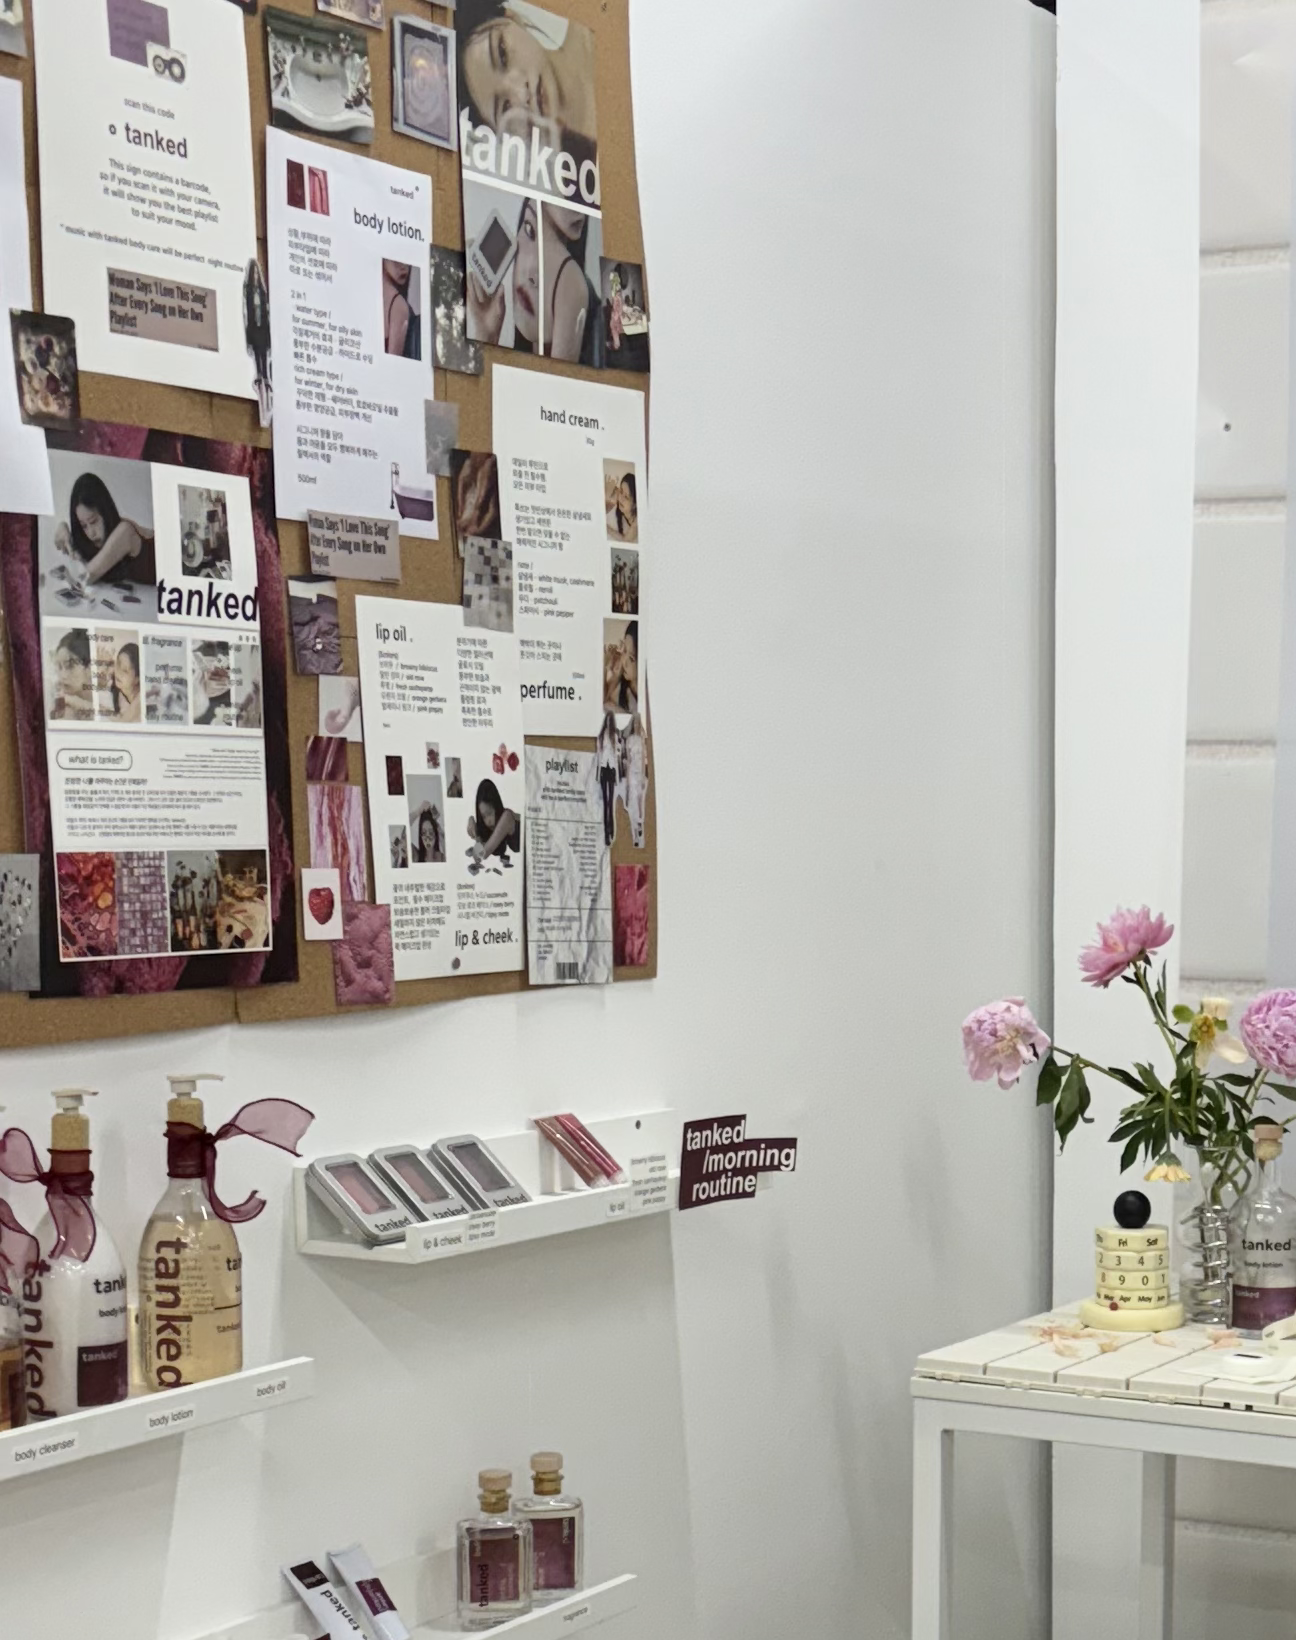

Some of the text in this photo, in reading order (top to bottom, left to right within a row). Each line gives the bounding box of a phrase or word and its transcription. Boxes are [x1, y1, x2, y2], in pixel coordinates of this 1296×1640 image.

[124, 122, 188, 159] tanked
[117, 176, 132, 188] you
[390, 186, 414, 200] tanked
[354, 207, 425, 242] body lotion.
[540, 405, 600, 431] hand cream
[157, 578, 259, 622] tanked
[375, 623, 407, 644] lip oil
[520, 681, 576, 702] perfume
[546, 758, 579, 775] playlist
[455, 928, 513, 950] lip & cheek
[686, 1118, 745, 1151] tanked
[702, 1145, 797, 1174] /morning
[692, 1173, 757, 1202] routine
[492, 1193, 528, 1208] tanked
[433, 1205, 470, 1220] tanked
[374, 1216, 414, 1233] tanked
[1118, 1238, 1158, 1247] Fri Sat
[1241, 1238, 1292, 1251] tanked
[1115, 1255, 1122, 1266] 3
[1138, 1256, 1145, 1266] 4
[1158, 1254, 1164, 1265] 5
[1118, 1275, 1126, 1285] 9
[1141, 1275, 1149, 1286] 0
[1161, 1273, 1166, 1284] 1
[1119, 1295, 1132, 1303] Apr
[155, 1237, 193, 1389] tanked
[22, 1259, 57, 1418] tanked
[256, 1380, 287, 1398] body oil
[149, 1408, 194, 1428] body lotion
[14, 1437, 76, 1463] body cleanser
[477, 1564, 489, 1607] tanked
[320, 1590, 361, 1631] tanked
